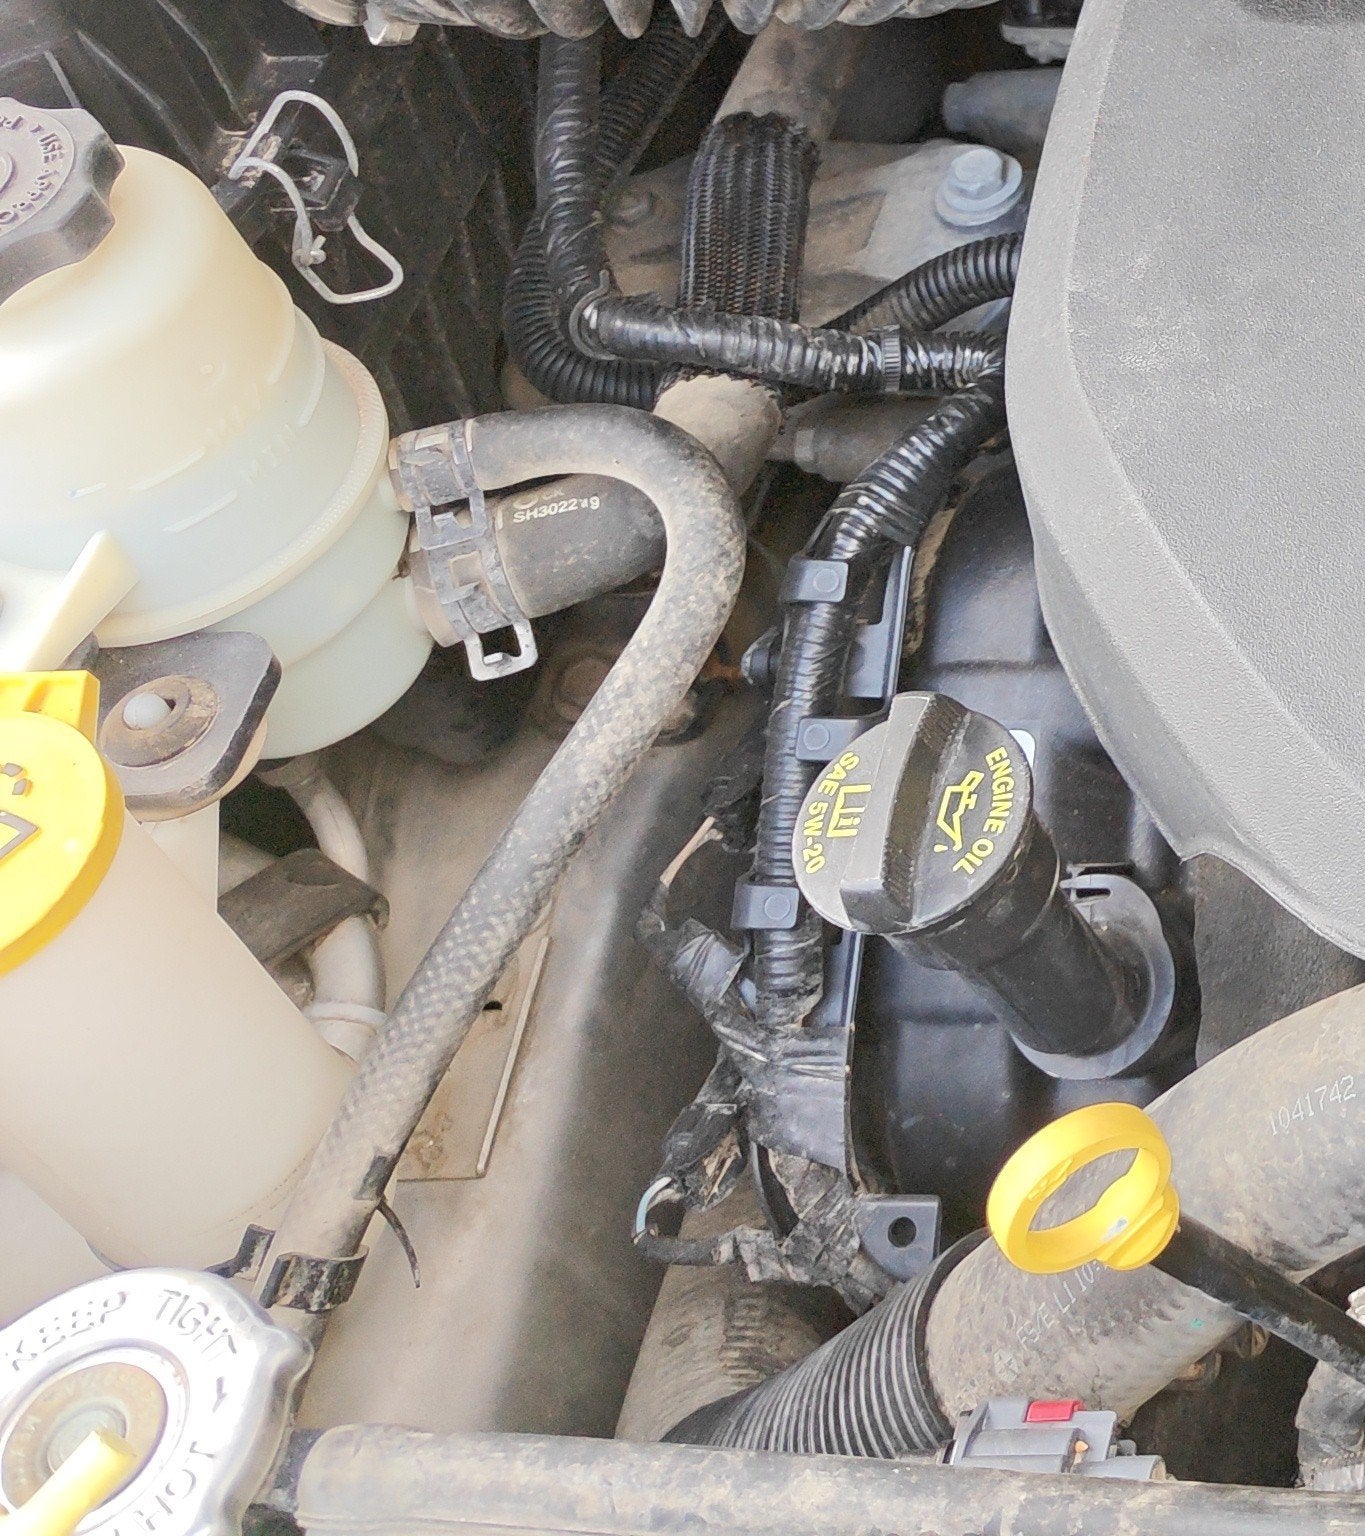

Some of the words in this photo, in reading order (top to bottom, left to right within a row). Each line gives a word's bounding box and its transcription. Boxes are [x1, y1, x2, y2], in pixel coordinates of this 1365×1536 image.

[817, 751, 860, 796] SAE
[983, 747, 1015, 835] ENGINE
[801, 801, 827, 874] 5W-20
[952, 837, 994, 875] OIL
[1270, 1075, 1357, 1137] 1041742
